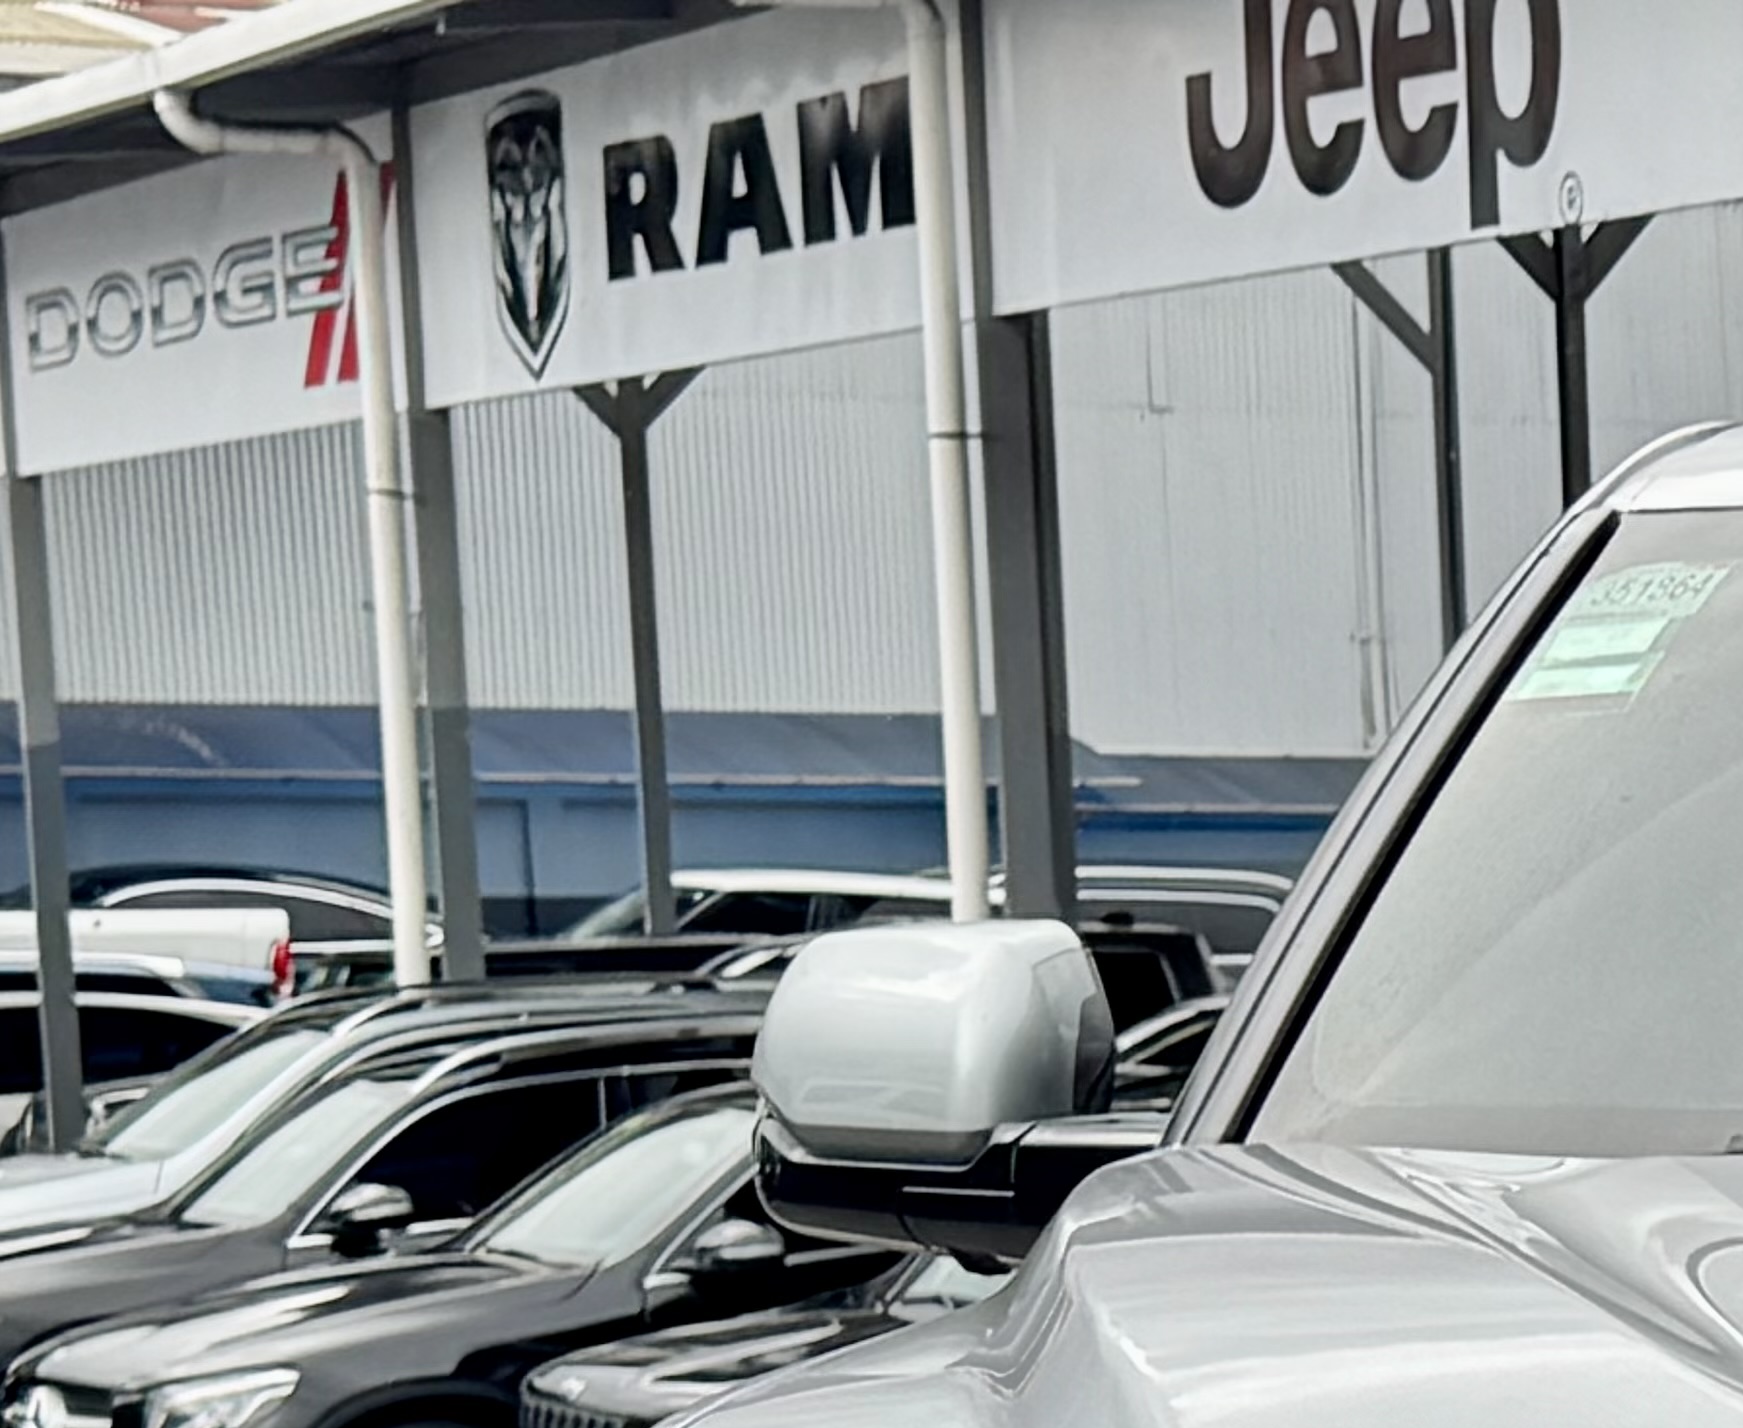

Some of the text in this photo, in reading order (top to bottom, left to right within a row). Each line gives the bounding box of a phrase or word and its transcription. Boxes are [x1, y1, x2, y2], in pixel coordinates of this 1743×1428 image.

[602, 74, 917, 282] RAM
[1185, 0, 1562, 231] Jeep
[25, 224, 348, 374] DODGE
